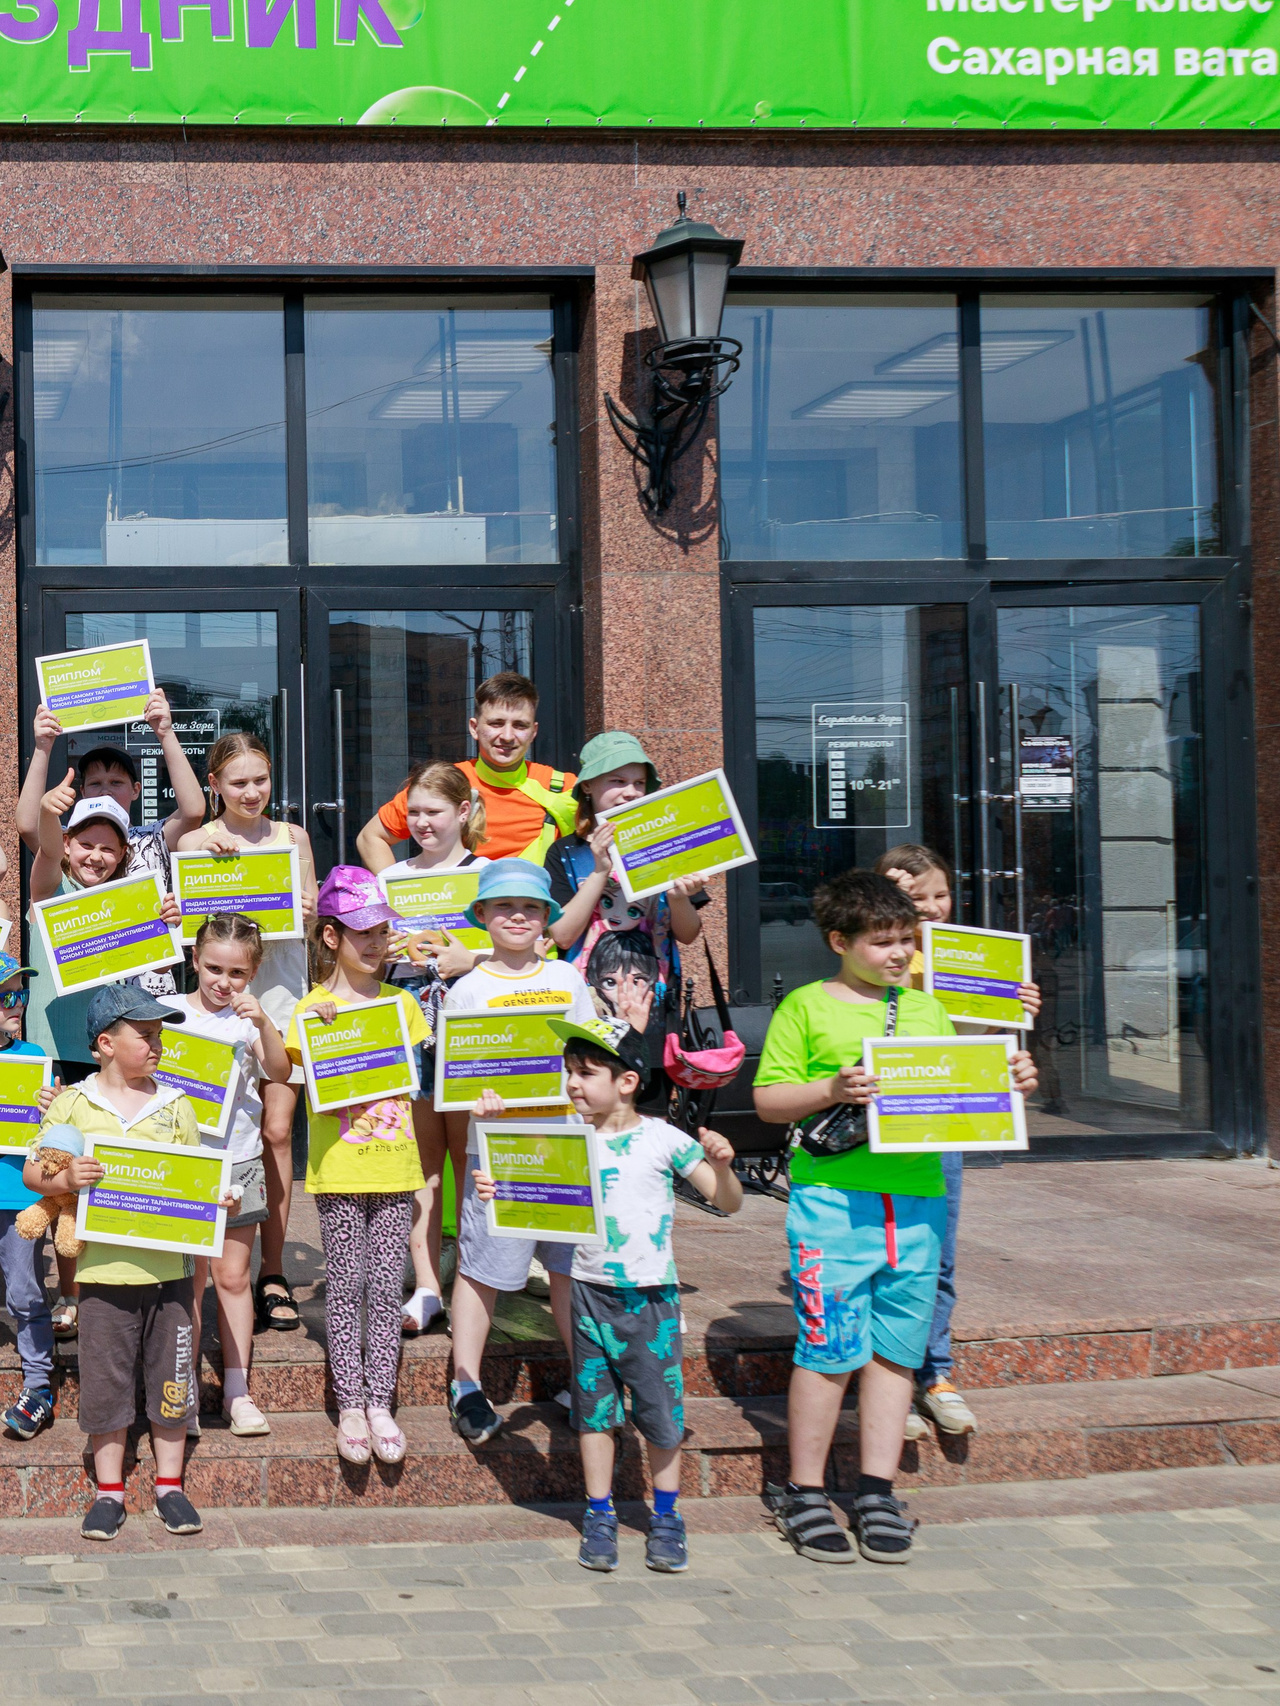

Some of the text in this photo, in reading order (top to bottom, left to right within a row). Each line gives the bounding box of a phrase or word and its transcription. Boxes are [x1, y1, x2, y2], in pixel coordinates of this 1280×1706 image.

[927, 37, 1277, 85] Сахарная вата
[47, 667, 101, 684] ДИПЛОМ
[51, 695, 70, 703] ВЫДАН
[70, 691, 94, 700] САМОМУ
[51, 695, 105, 708] ЮНОМУ КОНДИТЕРУ
[189, 721, 214, 734] Зори
[616, 812, 676, 842] ДИПЛОМ
[184, 872, 242, 886] ДИПЛОМ
[234, 896, 280, 904] ТАЛАНТЛИВОМУ
[392, 891, 452, 905] ДИПЛОМ
[51, 907, 112, 934] ДИПЛОМ
[59, 944, 80, 955] ВЫДАН
[81, 937, 107, 949] САМОМУ
[107, 923, 155, 941] ТАЛАНТЛИВОМУ
[60, 939, 120, 961] ЮНОМУ КОНДИТЕРУ
[514, 987, 552, 997] FUTURE
[503, 996, 566, 1007] GENERATION
[310, 1027, 361, 1047] ДИПЛОМ
[449, 1033, 512, 1047] ДИПЛОМ
[879, 1065, 950, 1079] ДИПЛОМ
[491, 1152, 544, 1166] ДИПЛОМ
[97, 1162, 165, 1181] ДИПЛОМ
[95, 1191, 204, 1211] ВЫДАН САМОМУ ТАЛАНТЛИВОМУ
[95, 1198, 161, 1212] ЮНОМУ КОНДИТЕРУ
[798, 1242, 828, 1345] HEAT
